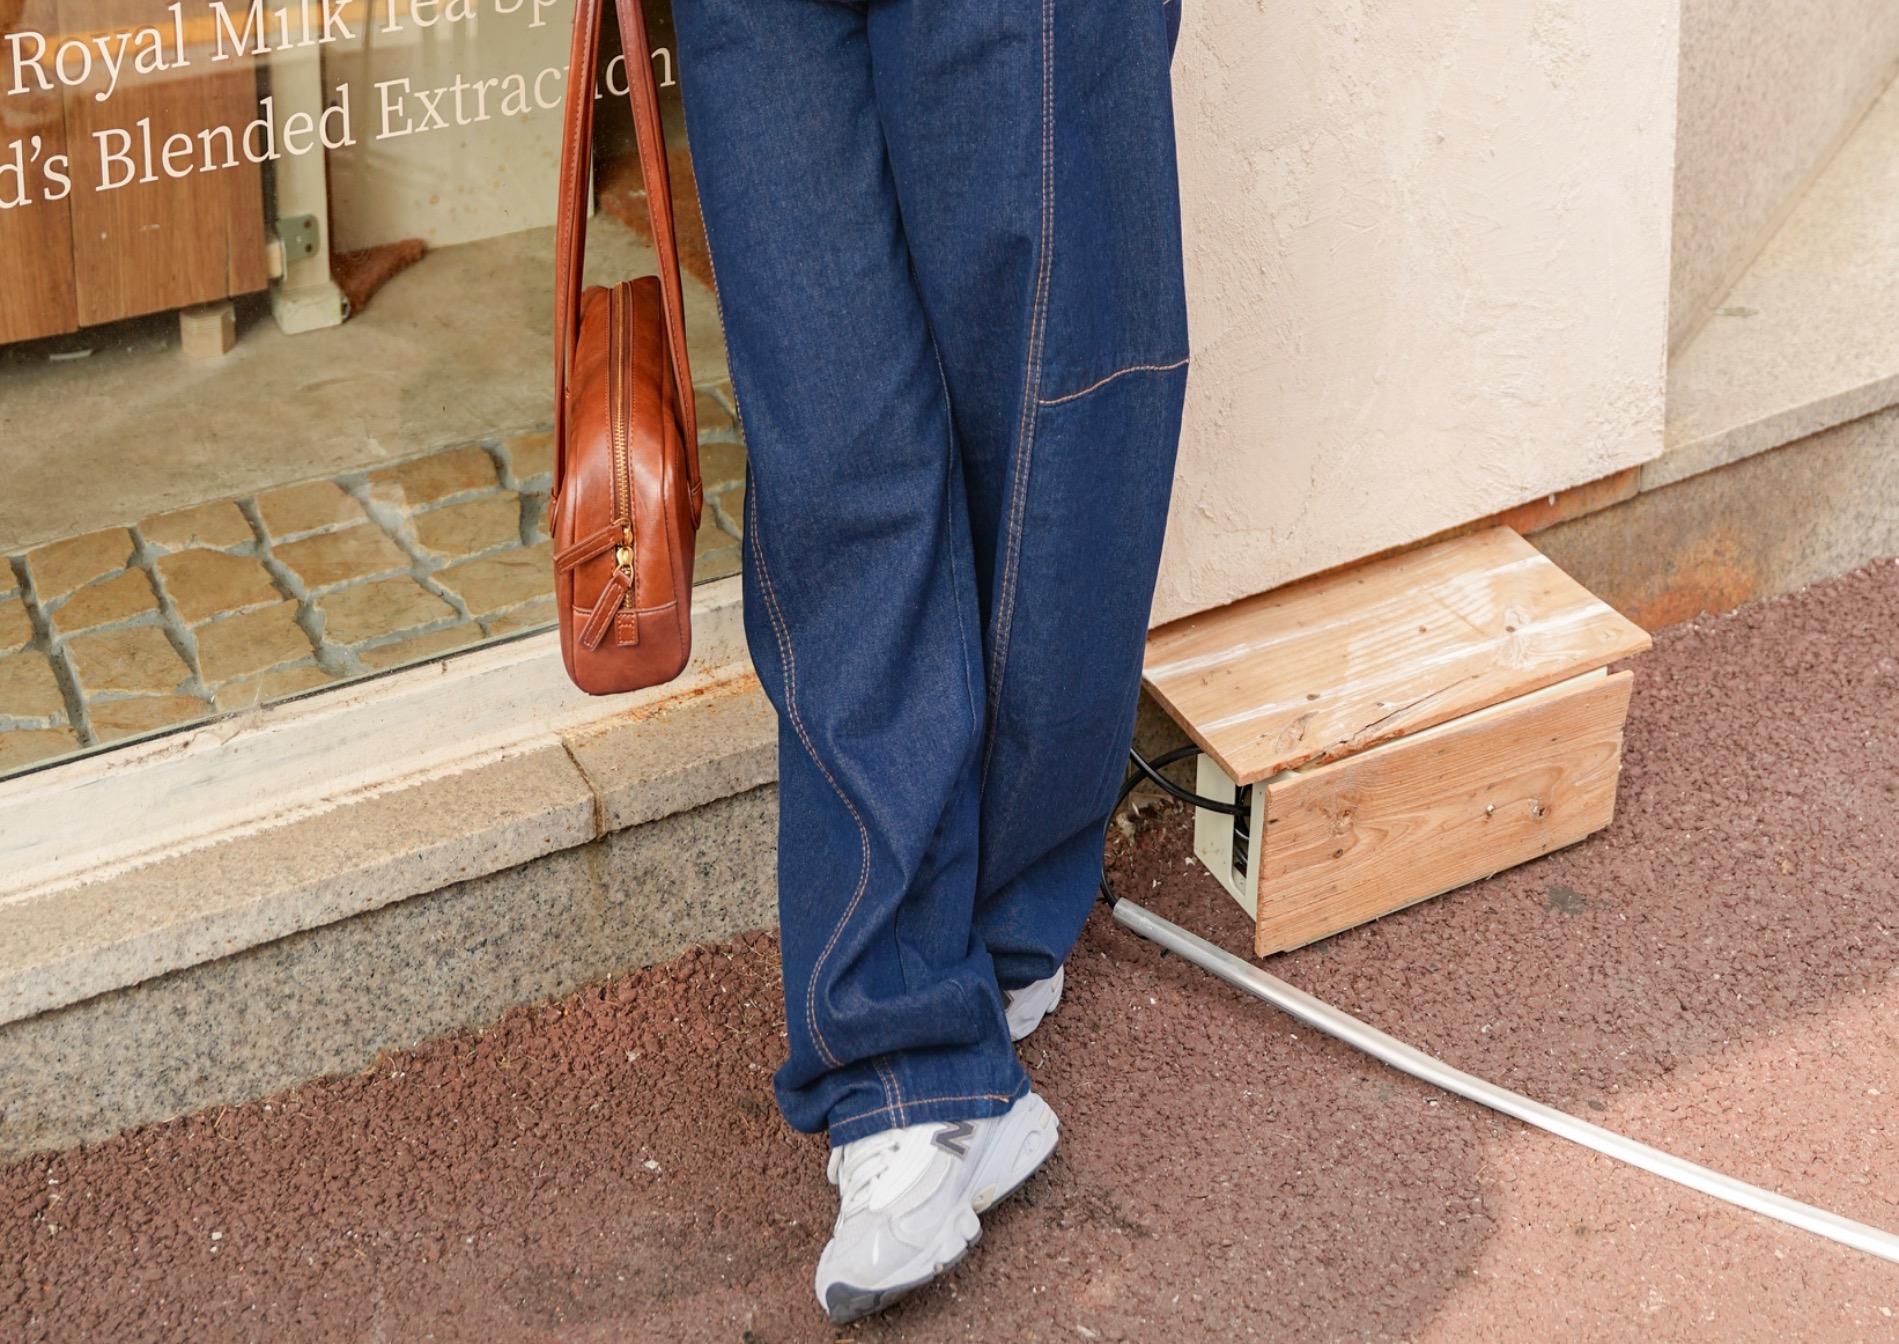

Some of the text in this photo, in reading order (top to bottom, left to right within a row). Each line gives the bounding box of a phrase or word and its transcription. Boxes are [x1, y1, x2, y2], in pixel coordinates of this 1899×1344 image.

[4, 2, 191, 102] Royal
[92, 83, 357, 192] Blended
[374, 47, 676, 140] Extracon
